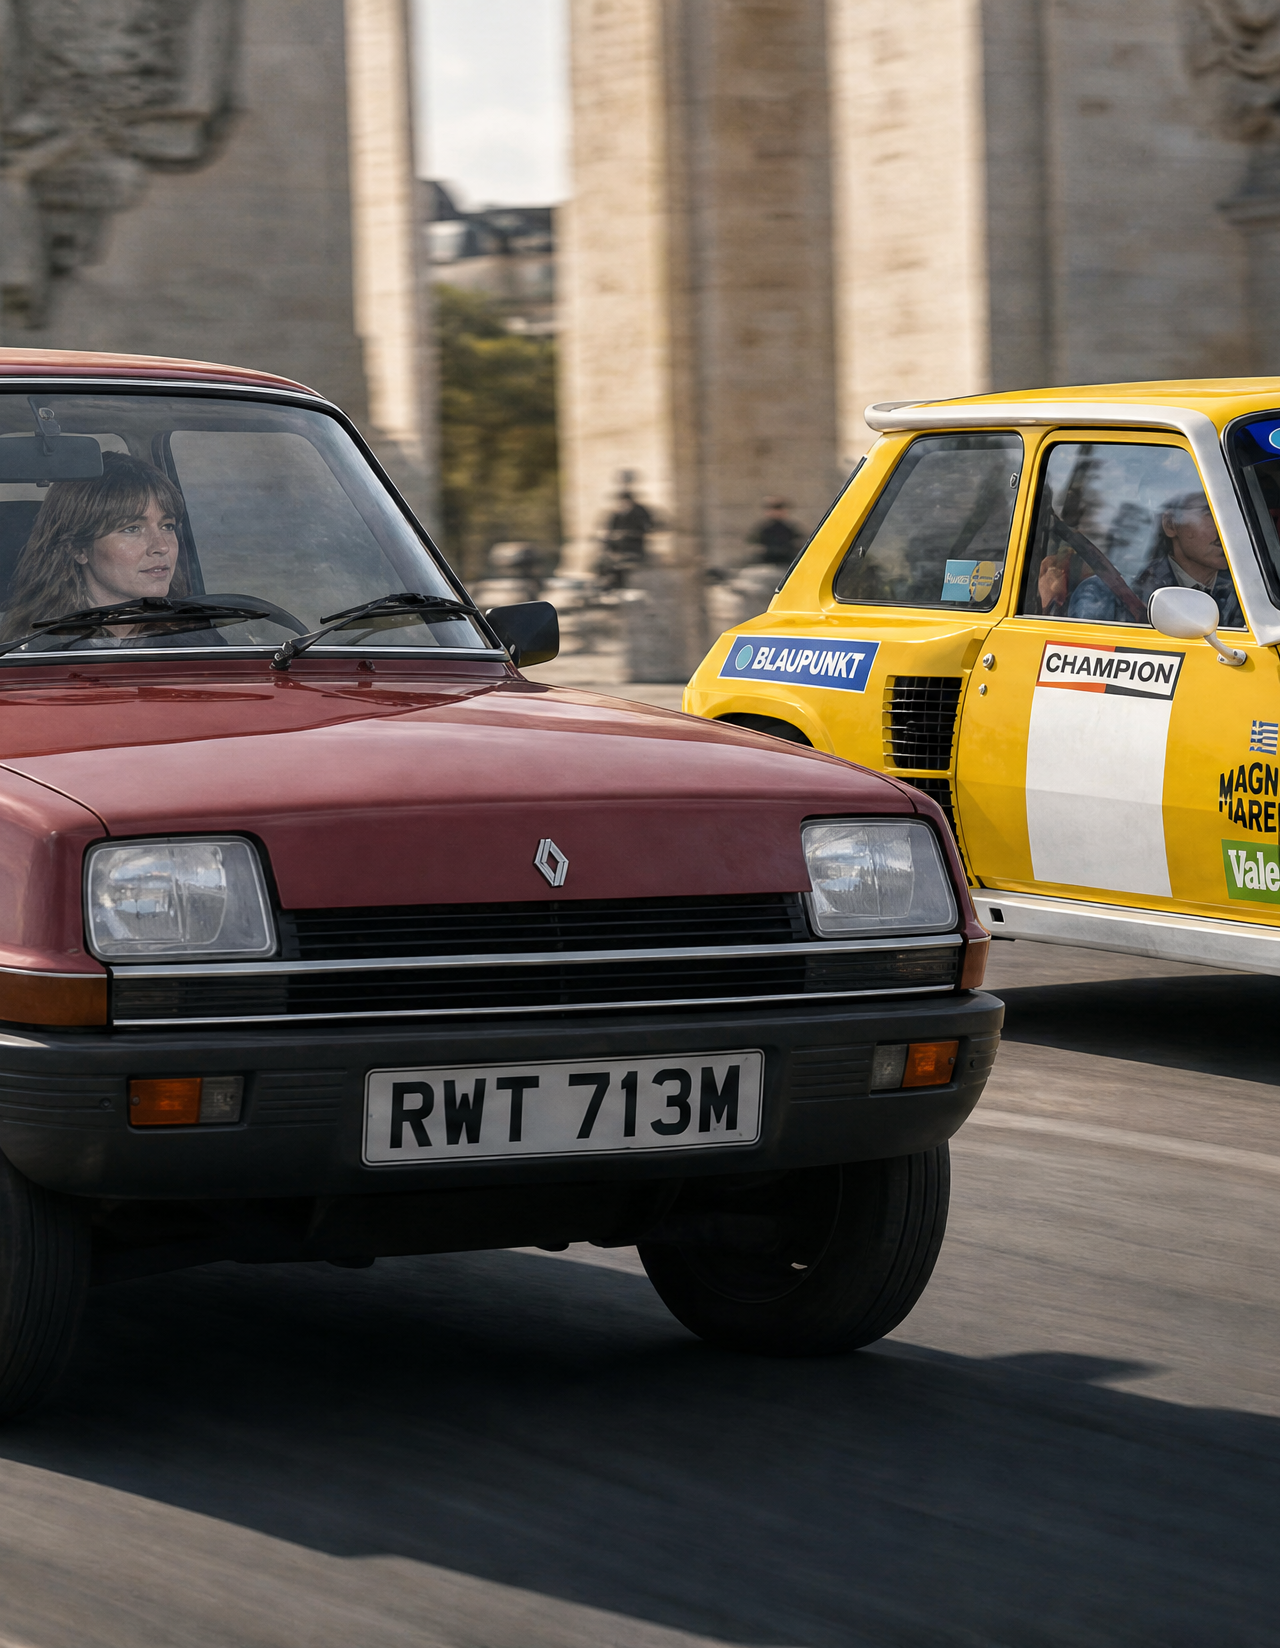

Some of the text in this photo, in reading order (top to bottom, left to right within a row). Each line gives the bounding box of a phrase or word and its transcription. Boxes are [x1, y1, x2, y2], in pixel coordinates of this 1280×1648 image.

[751, 646, 866, 679] BLAUPUNKT
[1045, 652, 1175, 684] CHAMPION
[389, 1064, 741, 1149] RWT 713M
